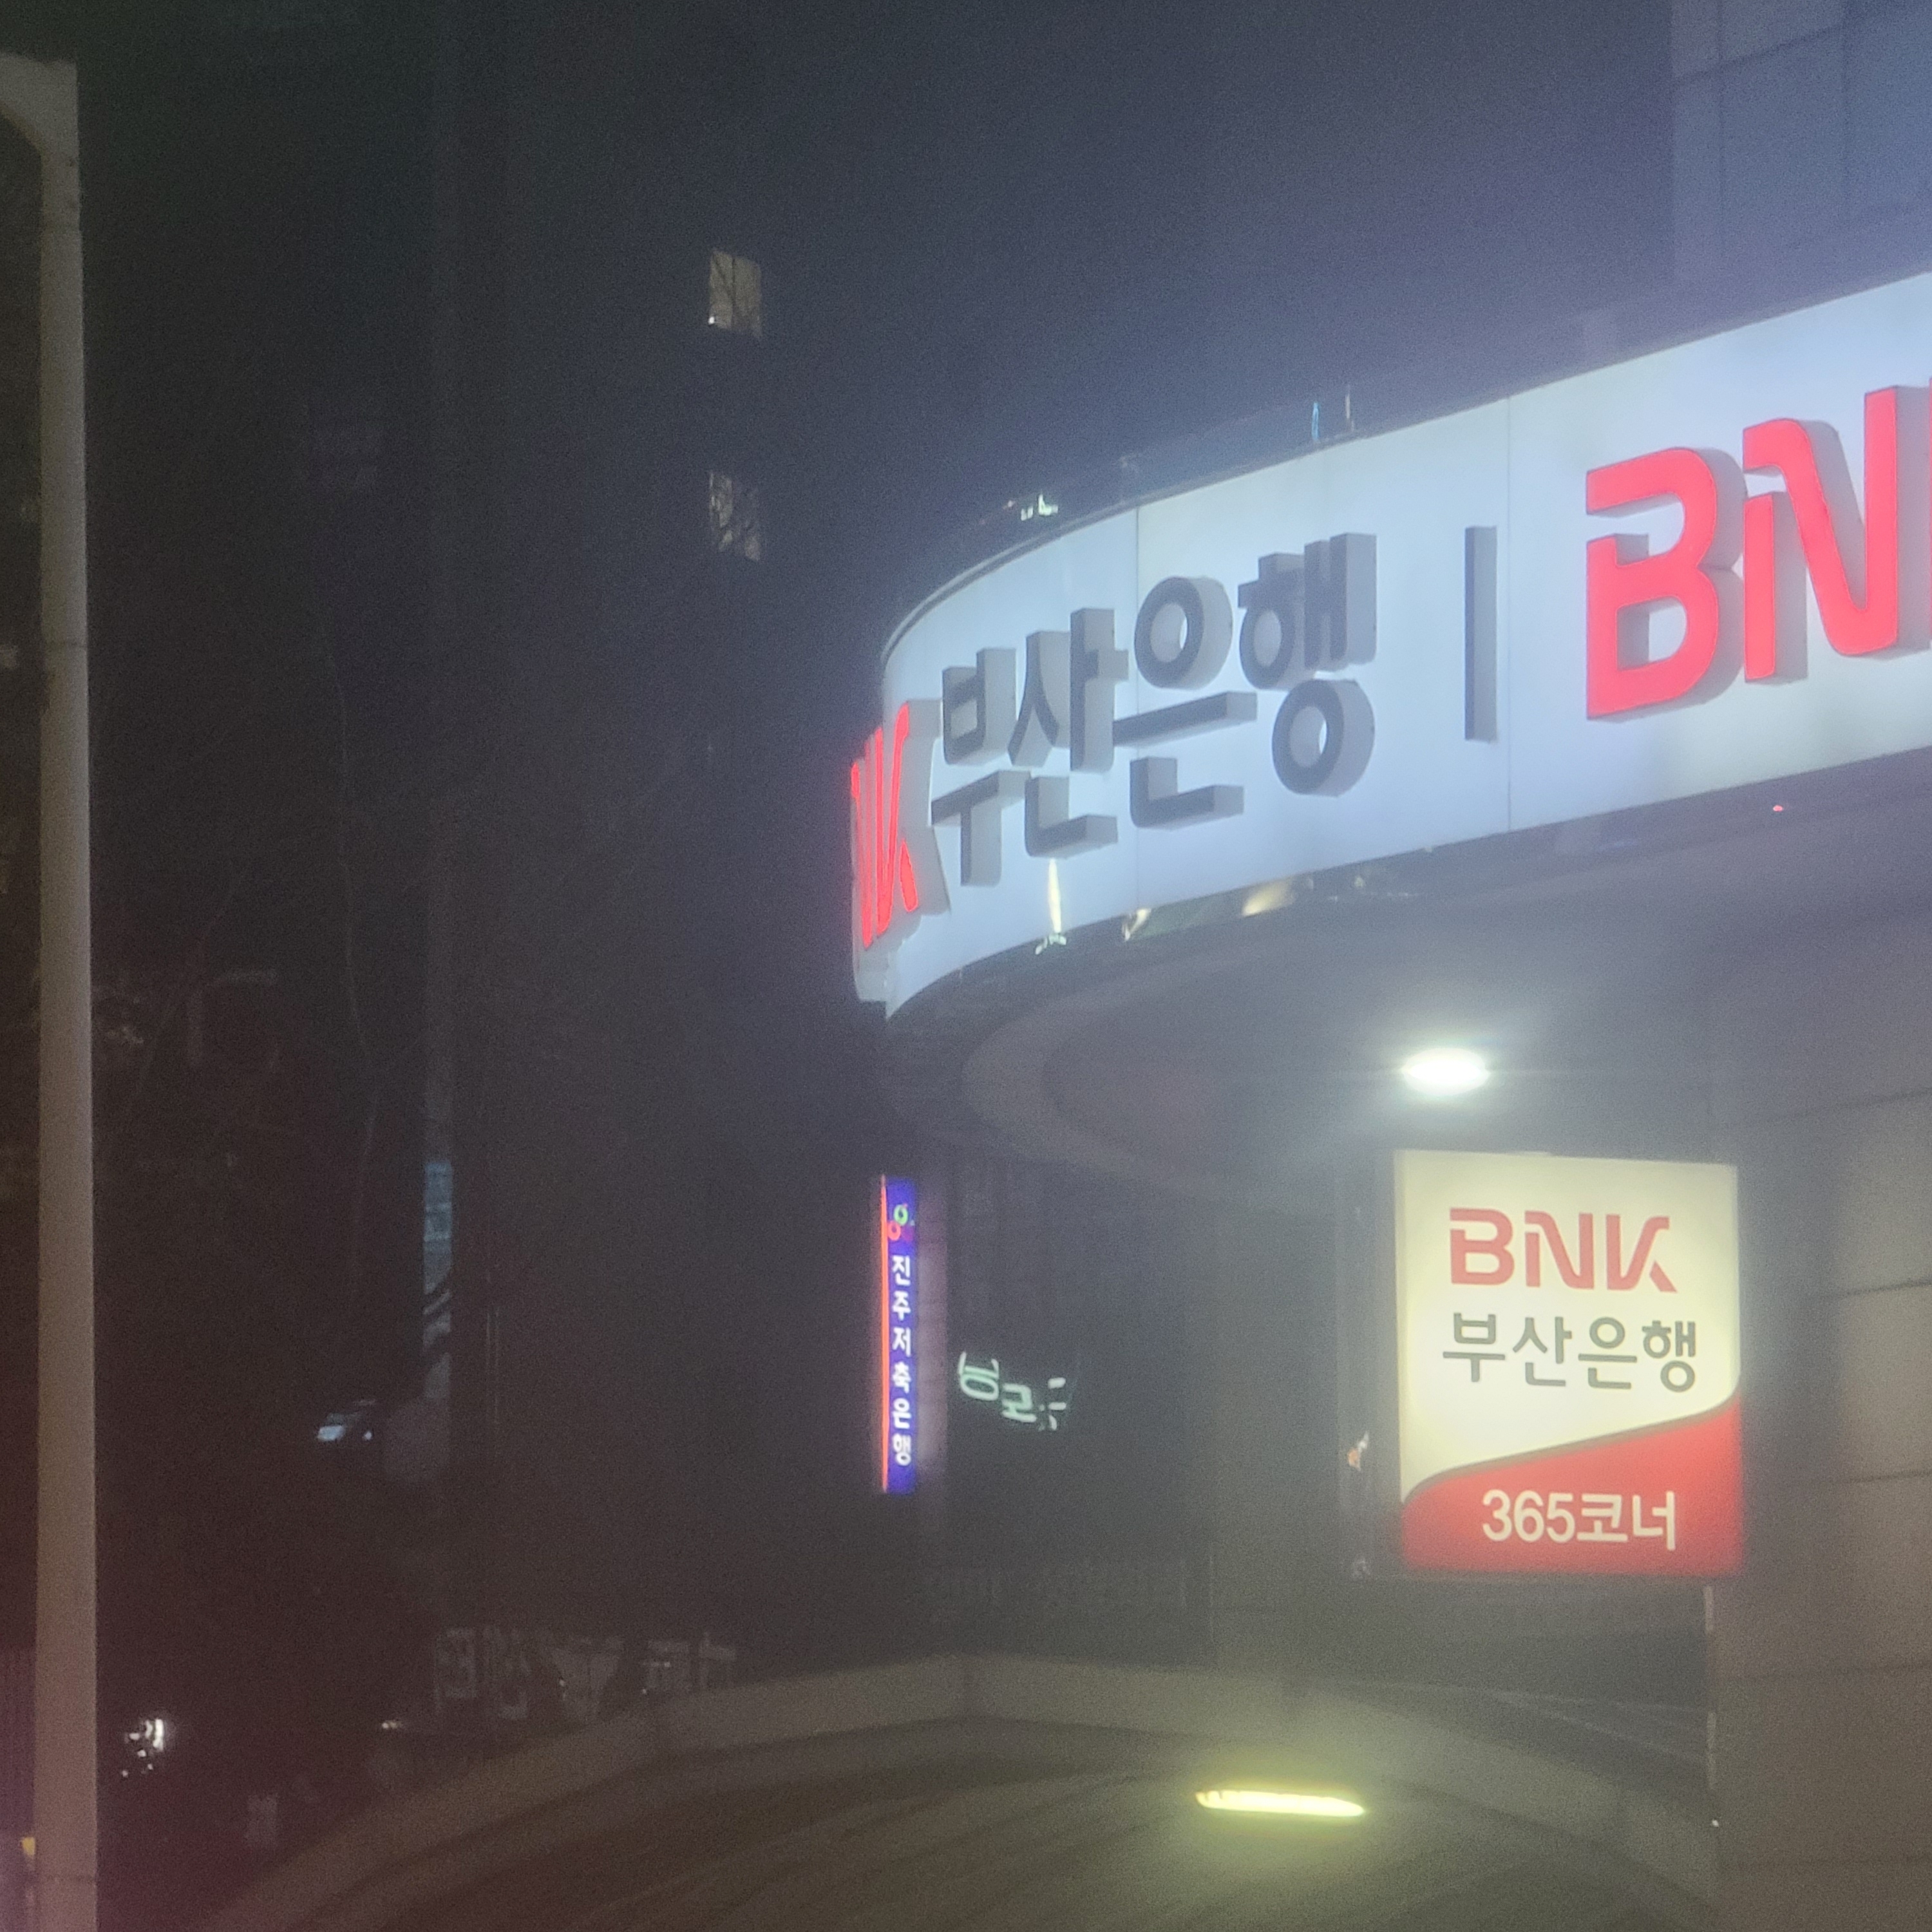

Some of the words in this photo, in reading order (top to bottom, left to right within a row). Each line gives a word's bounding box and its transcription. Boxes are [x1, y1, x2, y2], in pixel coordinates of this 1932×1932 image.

[1586, 377, 1932, 721] BN
[931, 533, 1377, 887] 부산은행
[1449, 1206, 1678, 1293] BNK
[891, 1255, 912, 1466] 진주저축은행
[1442, 1312, 1696, 1393] 부산은행
[1482, 1489, 1676, 1551] 365코너
